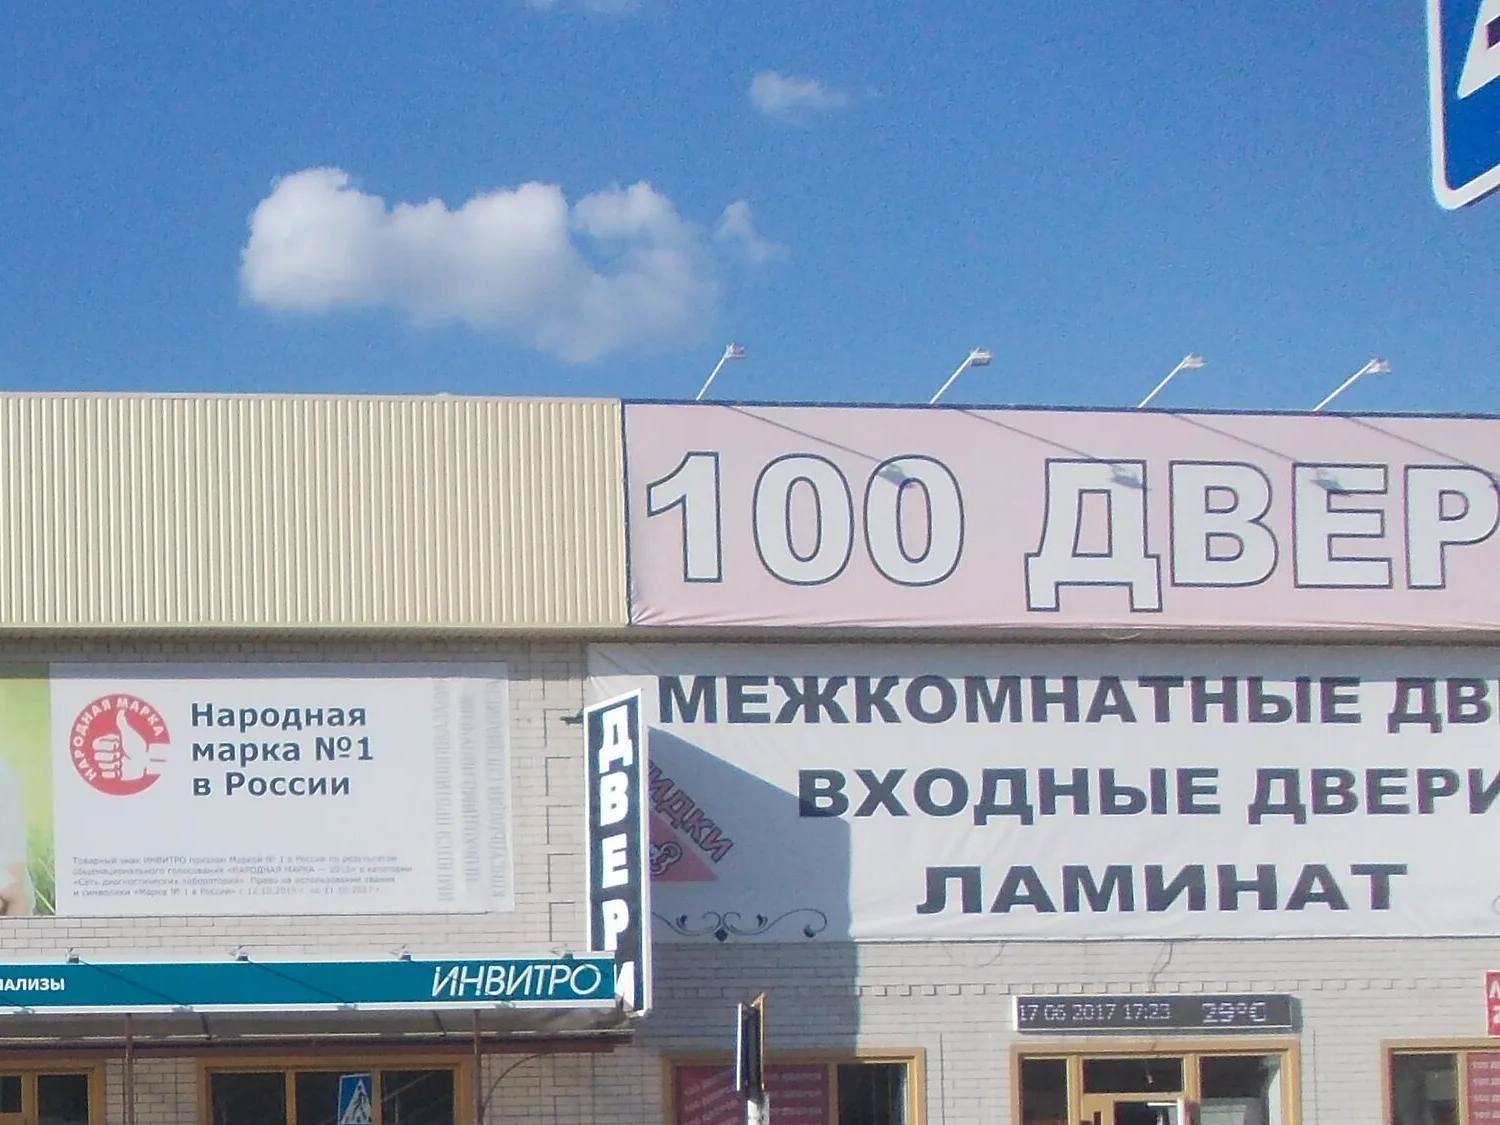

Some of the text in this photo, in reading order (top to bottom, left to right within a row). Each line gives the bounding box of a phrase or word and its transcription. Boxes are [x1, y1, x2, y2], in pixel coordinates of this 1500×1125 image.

[646, 451, 1500, 612] 100 ДВЕР
[191, 702, 367, 733] Народная
[658, 675, 1500, 734] МЕЖКОМНАТНЫЕ ДВ
[73, 696, 165, 781] НАРОДНАЯ МАРКА
[191, 741, 301, 768] марка
[193, 771, 351, 798] в России
[798, 767, 1500, 826] ВХОДНЫЕ ДВЕРИ
[916, 863, 1408, 915] ЛАМИНАТ
[431, 964, 602, 997] ИНВИТРО
[1072, 1004, 1116, 1020] 2017
